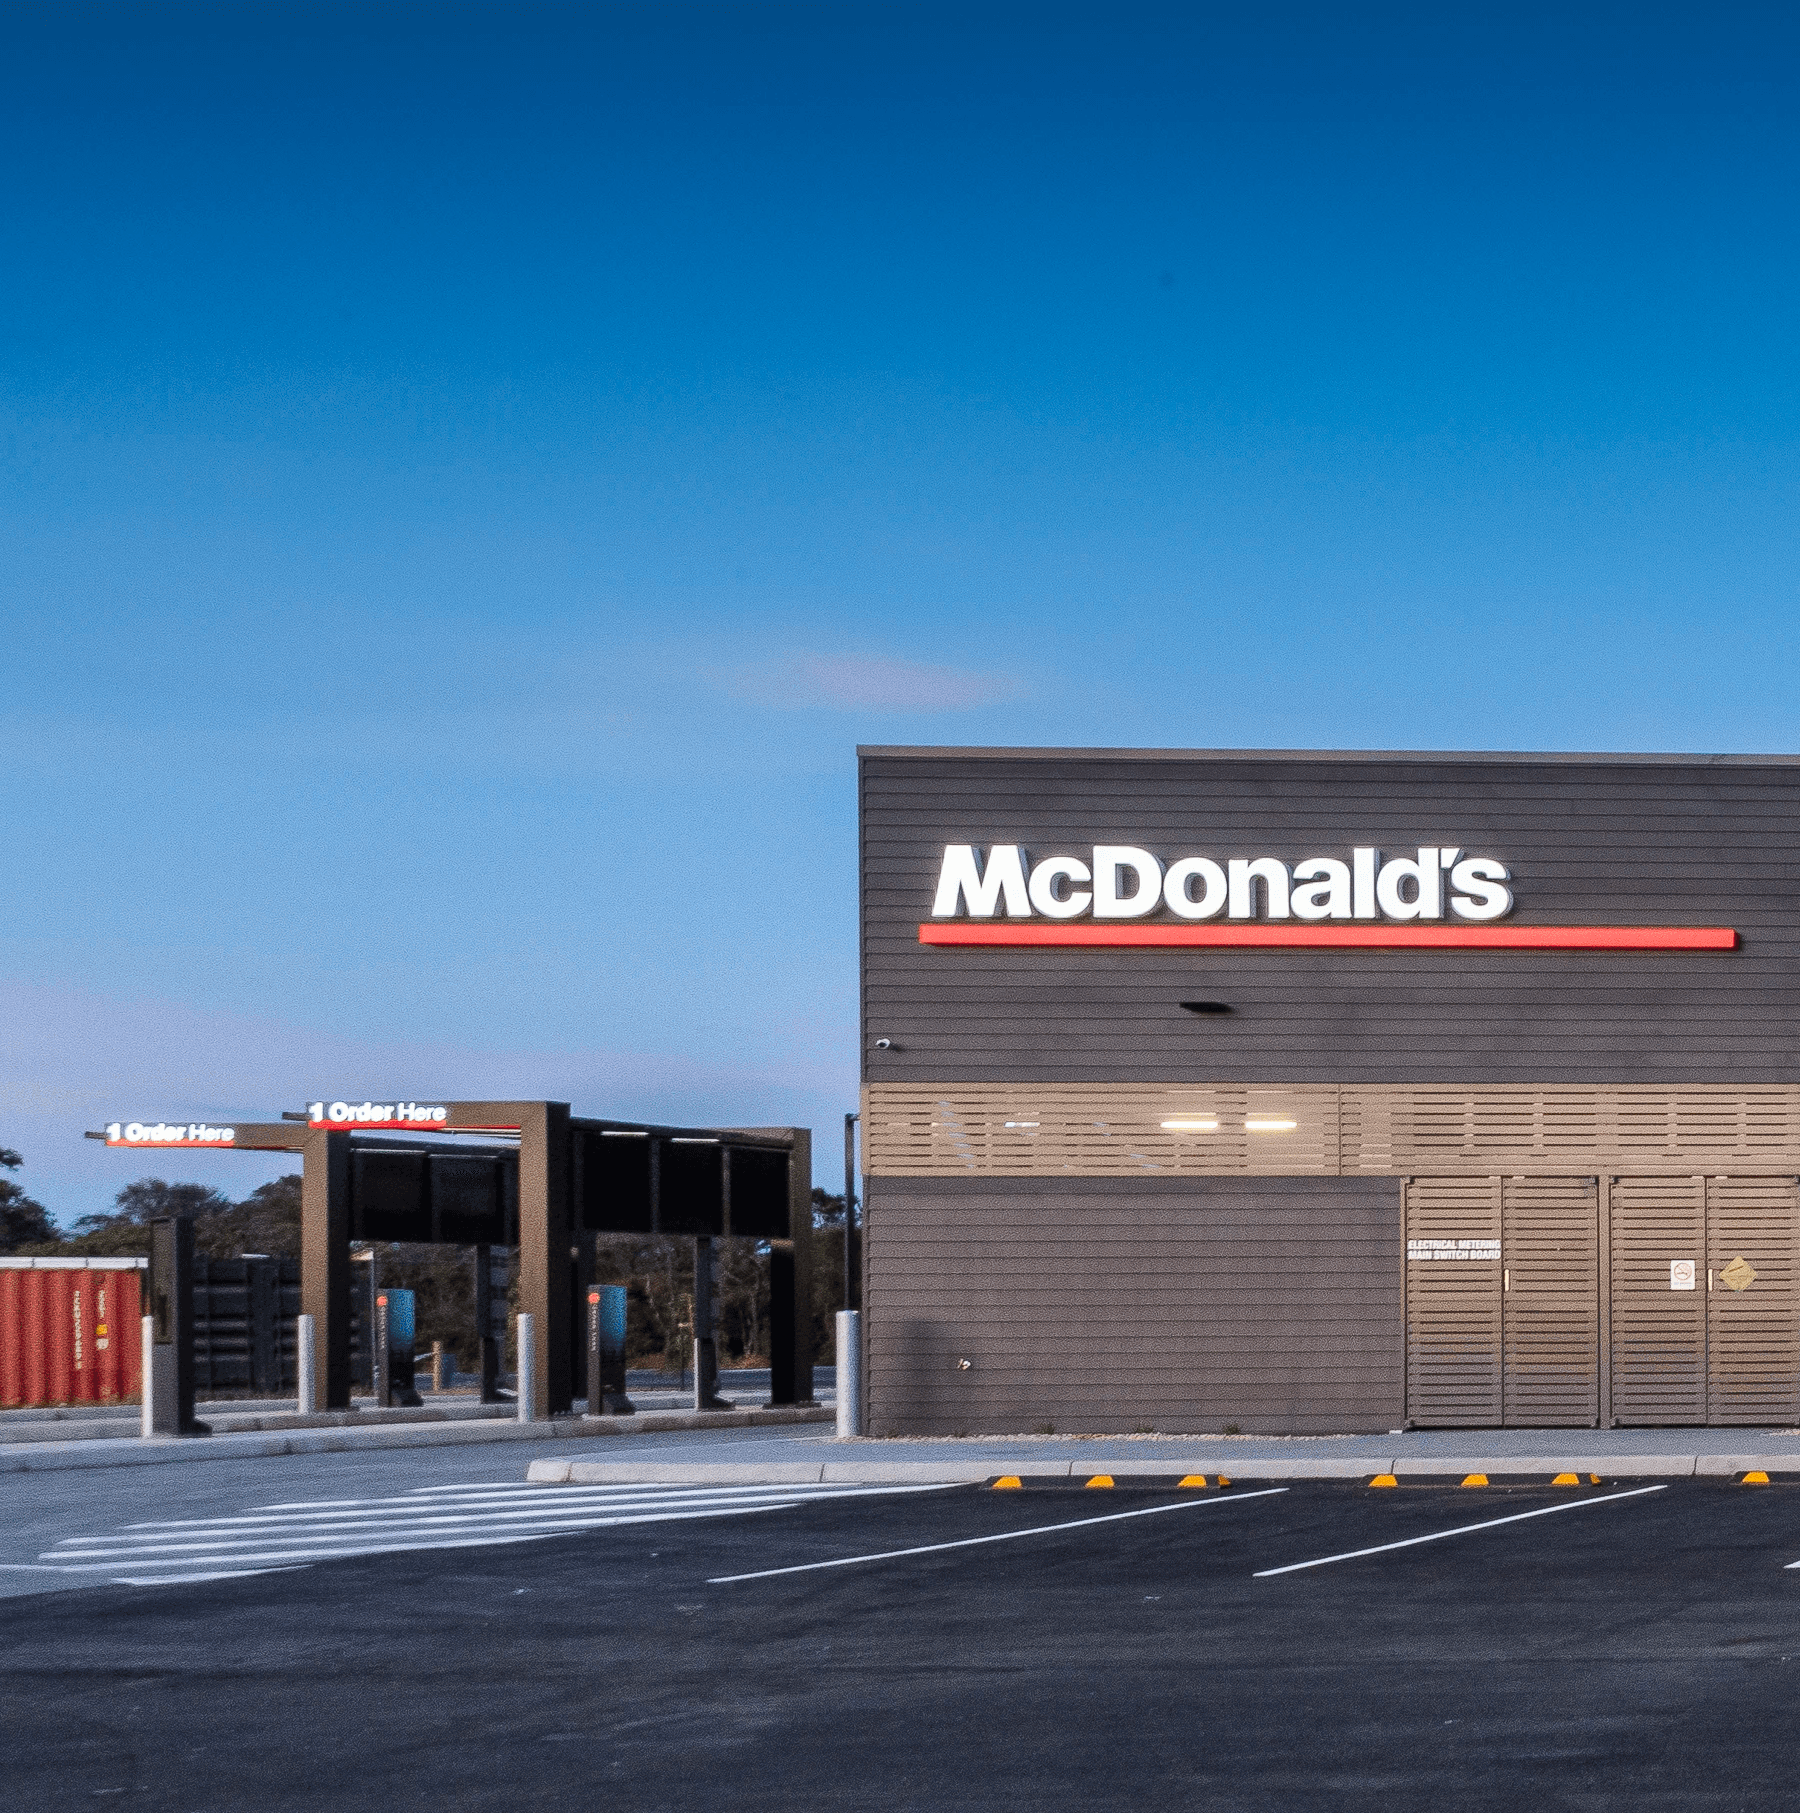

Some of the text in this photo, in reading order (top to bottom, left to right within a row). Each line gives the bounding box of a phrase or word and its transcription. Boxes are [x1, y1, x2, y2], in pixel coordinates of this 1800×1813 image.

[931, 843, 1509, 919] McDonald's
[307, 1101, 447, 1123] 1 Order Here
[106, 1122, 235, 1142] 1 Order Here
[1407, 1240, 1457, 1250] ELECTRICAL
[1434, 1250, 1469, 1260] SWITCH
[1470, 1250, 1501, 1260] BOARD
